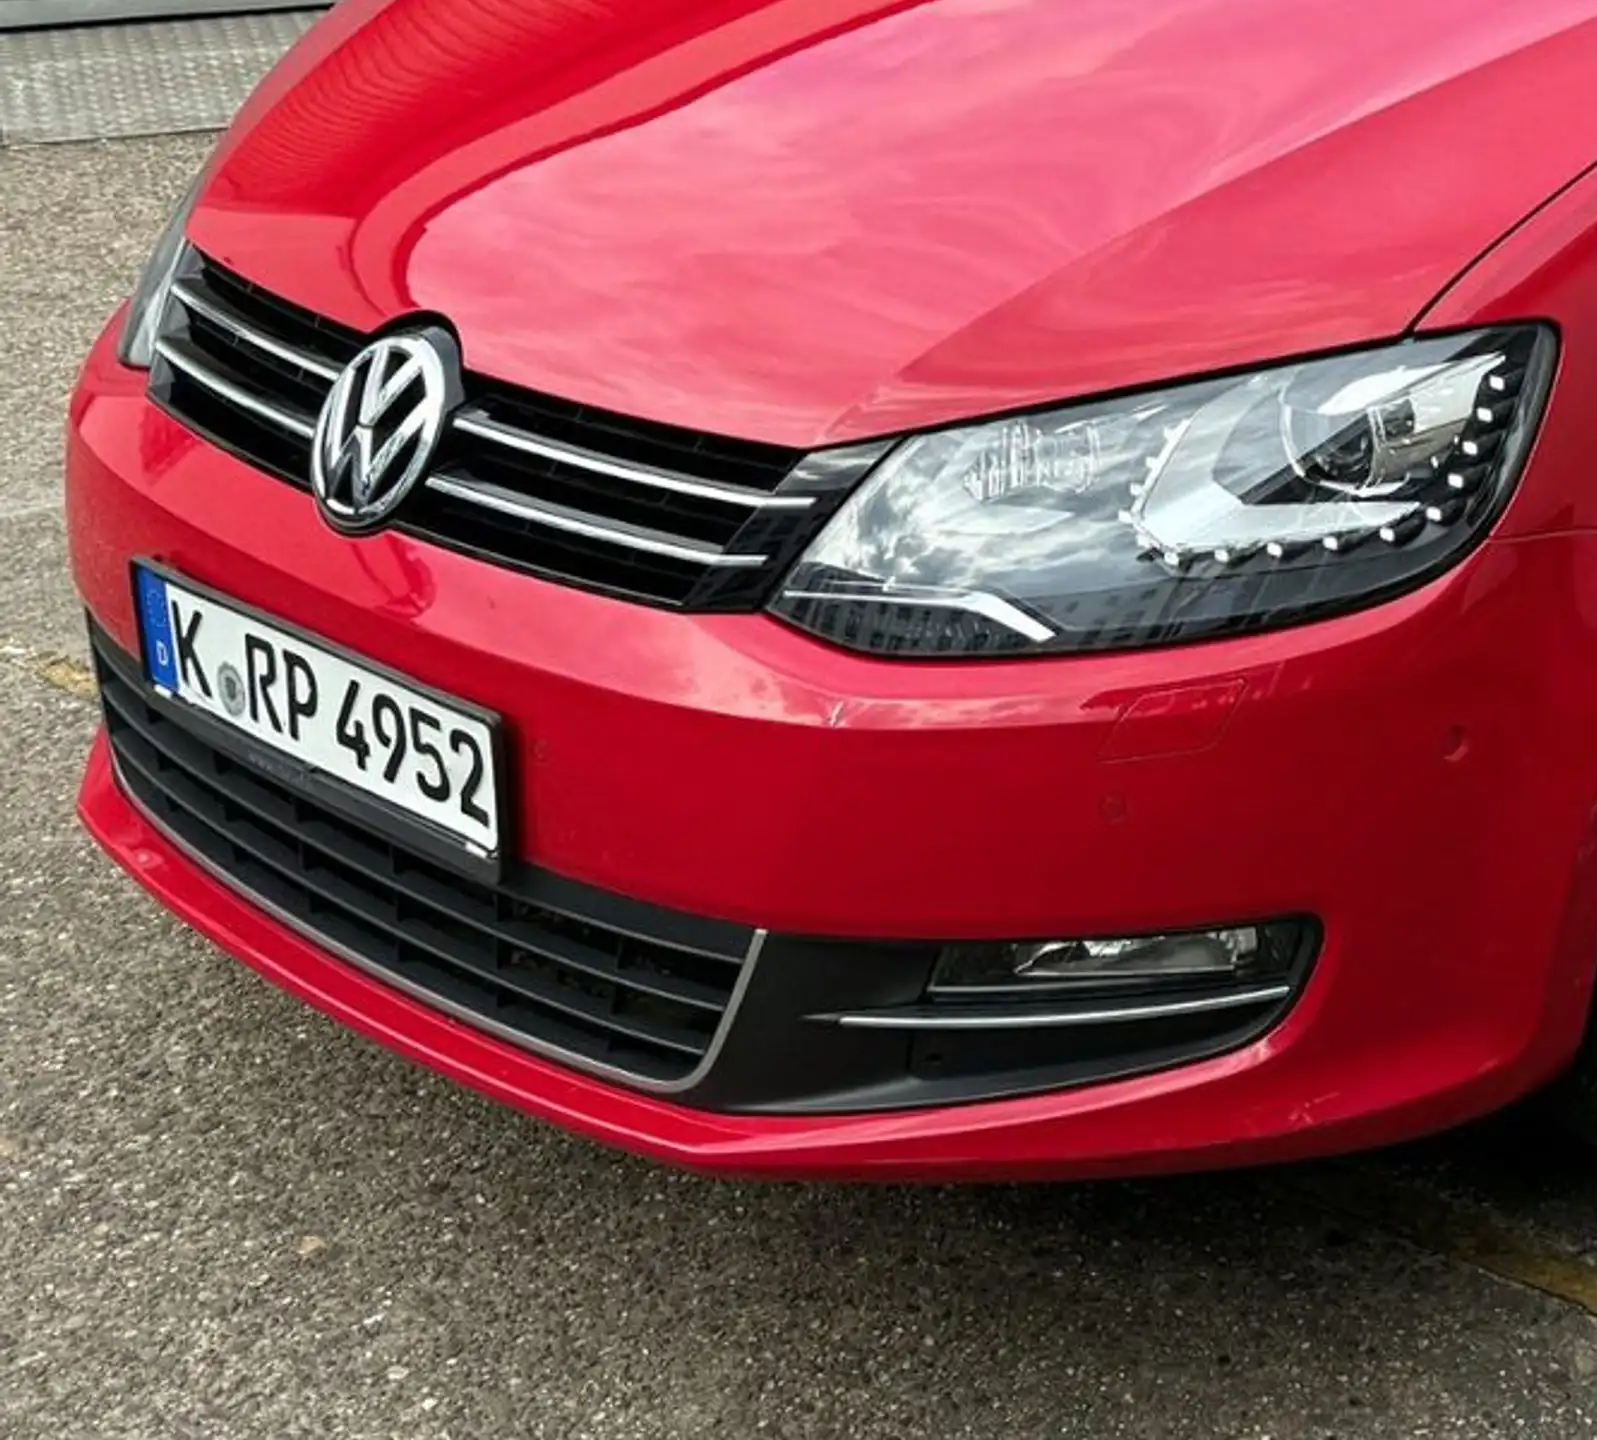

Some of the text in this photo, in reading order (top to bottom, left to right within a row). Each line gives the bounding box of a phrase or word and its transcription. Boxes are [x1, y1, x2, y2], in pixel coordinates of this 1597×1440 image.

[172, 600, 212, 698] K
[244, 633, 318, 741] RP
[336, 679, 489, 828] 4952
